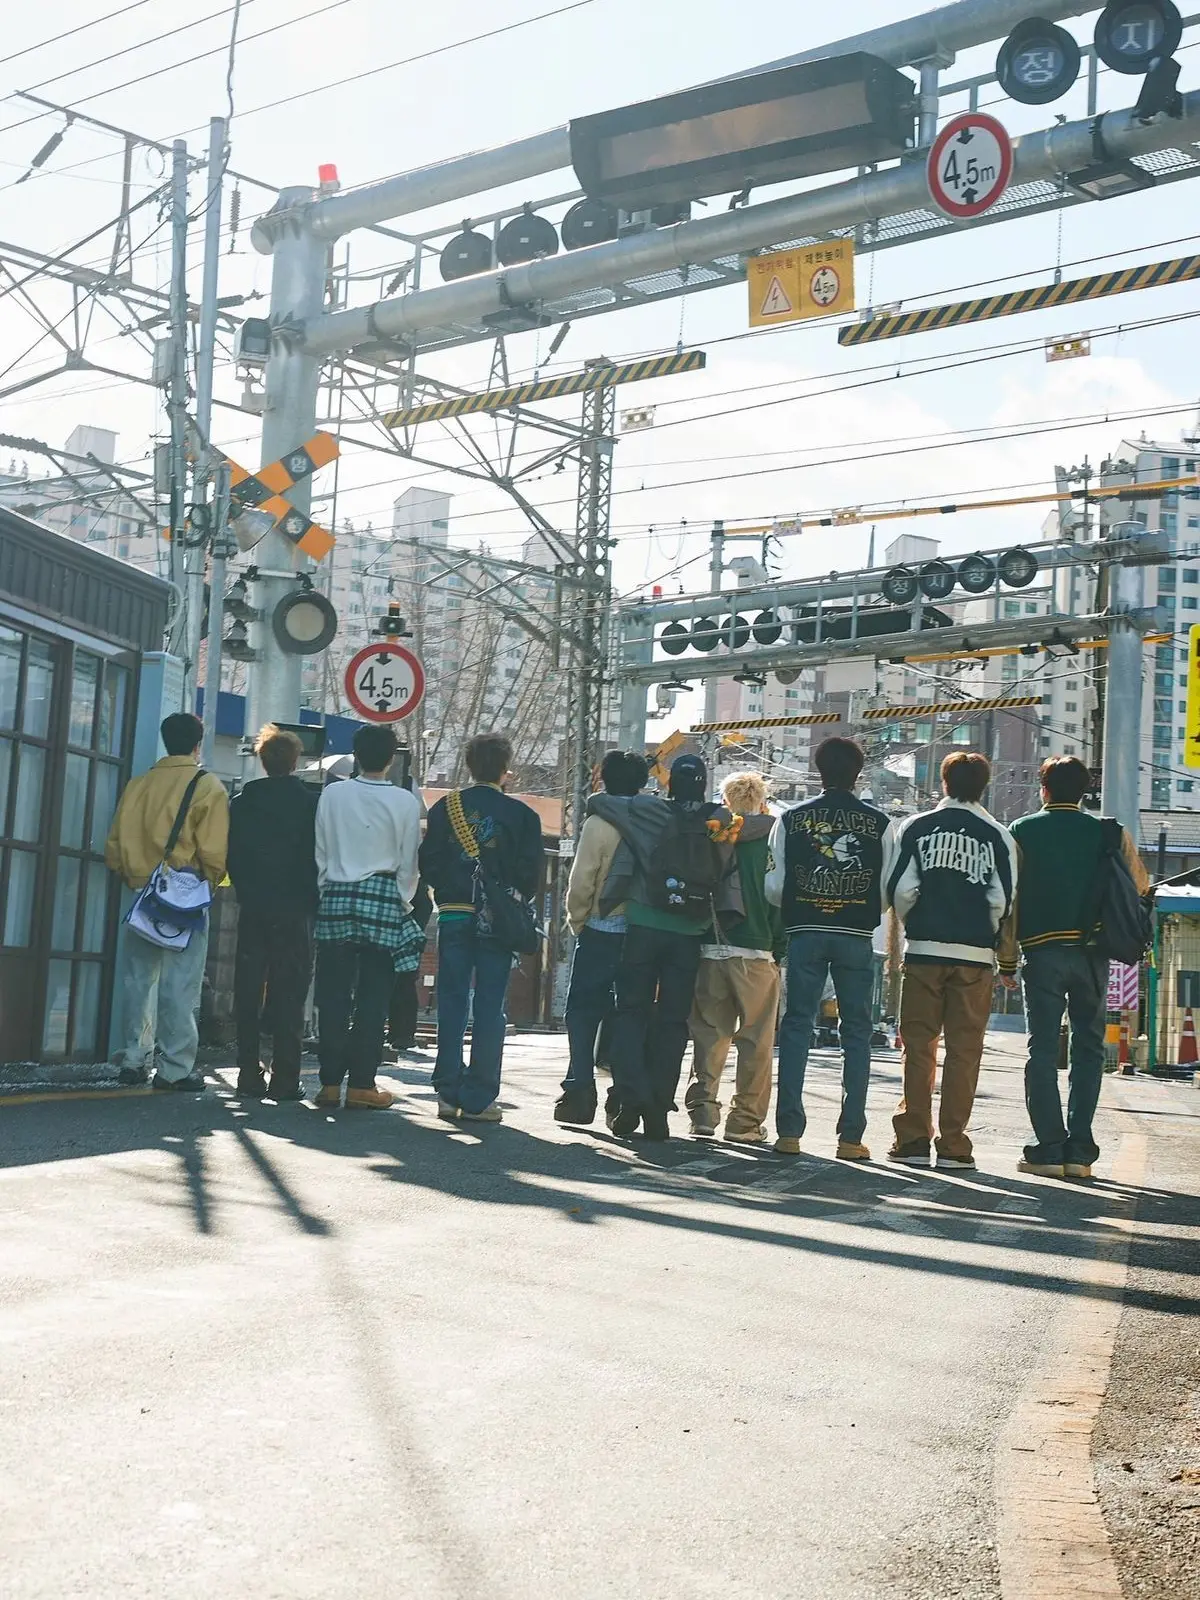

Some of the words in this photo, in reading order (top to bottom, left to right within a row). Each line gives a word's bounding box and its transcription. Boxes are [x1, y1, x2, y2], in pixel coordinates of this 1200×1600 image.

[943, 149, 996, 190] 4.5m
[359, 666, 409, 698] 4.5m
[789, 807, 879, 840] PALACE
[795, 864, 874, 897] SAINTS
